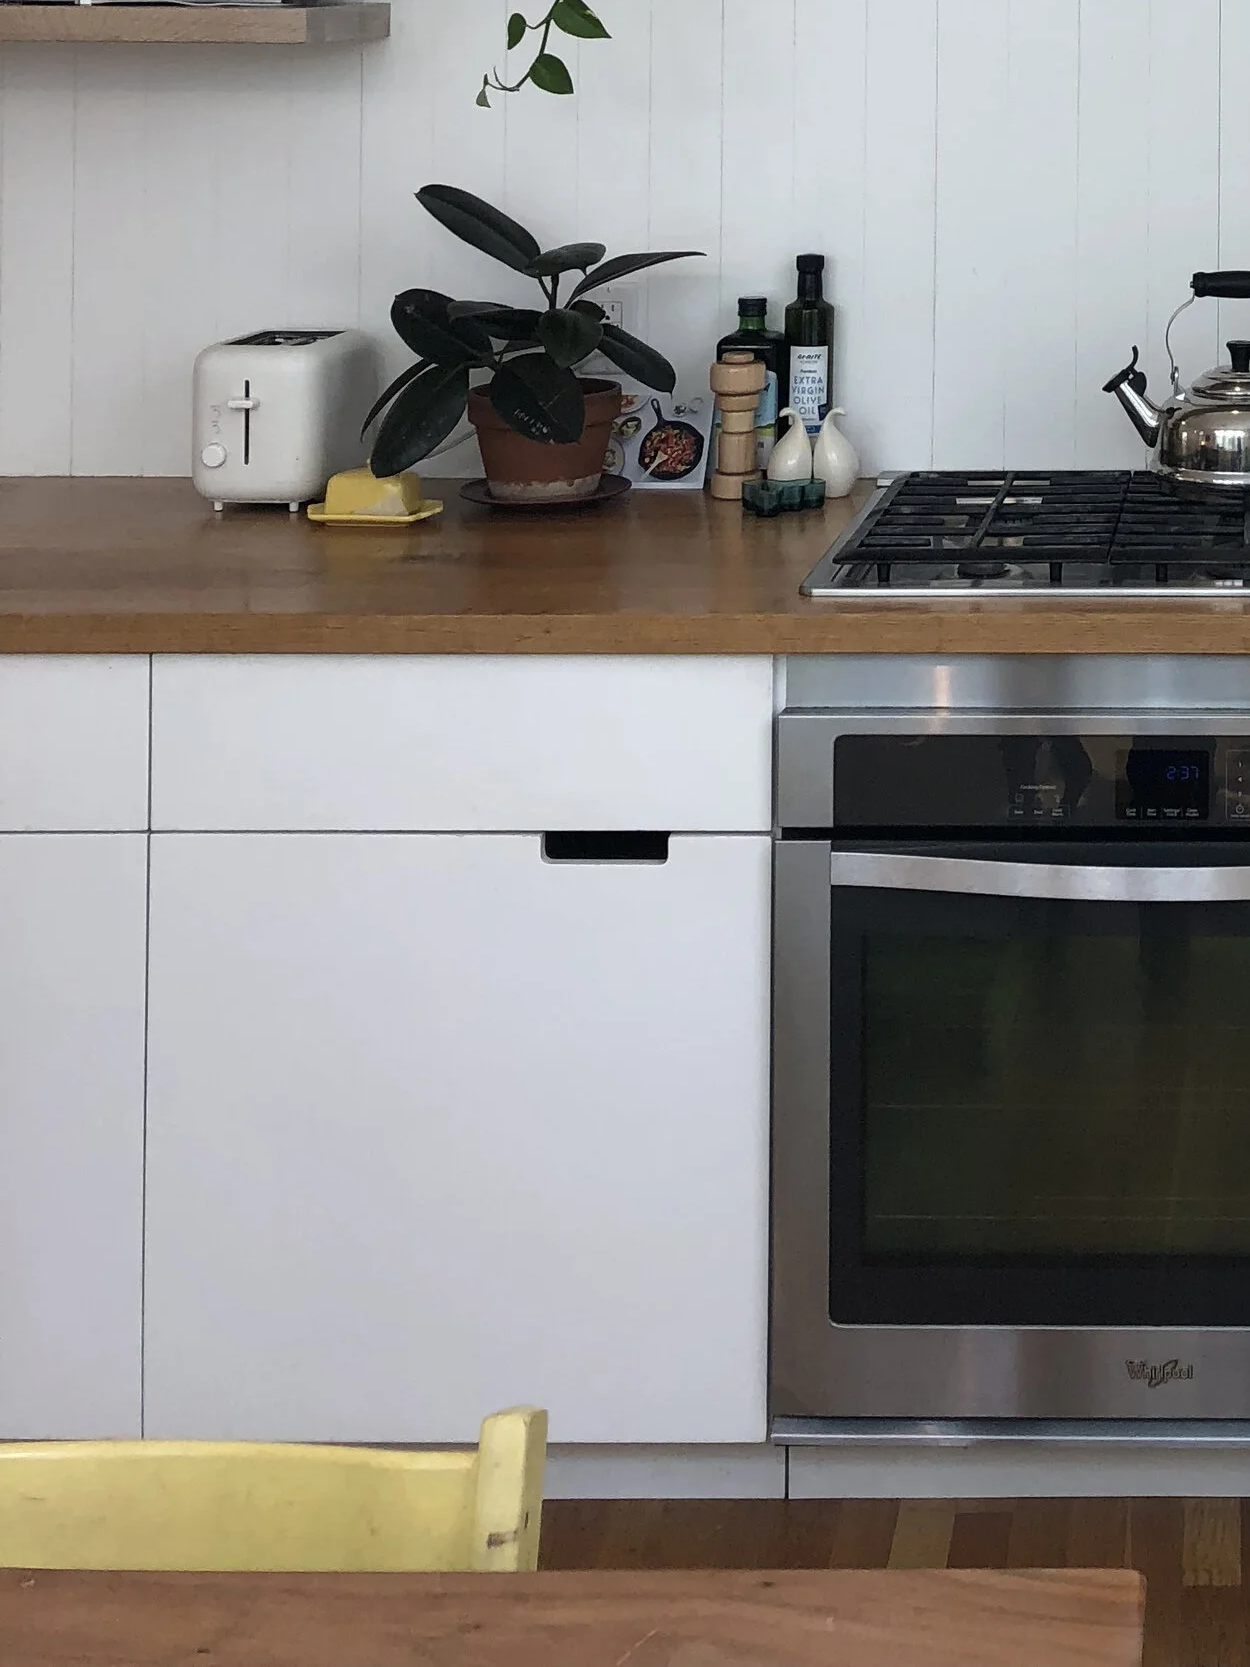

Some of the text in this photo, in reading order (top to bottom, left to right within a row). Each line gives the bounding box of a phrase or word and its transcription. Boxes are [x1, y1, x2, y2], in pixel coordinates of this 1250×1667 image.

[793, 375, 824, 385] EXTRA
[791, 386, 825, 395] VIRGIN
[793, 396, 821, 405] OLIVE
[799, 406, 816, 415] OIL
[1125, 1358, 1194, 1389] Whirlpool
